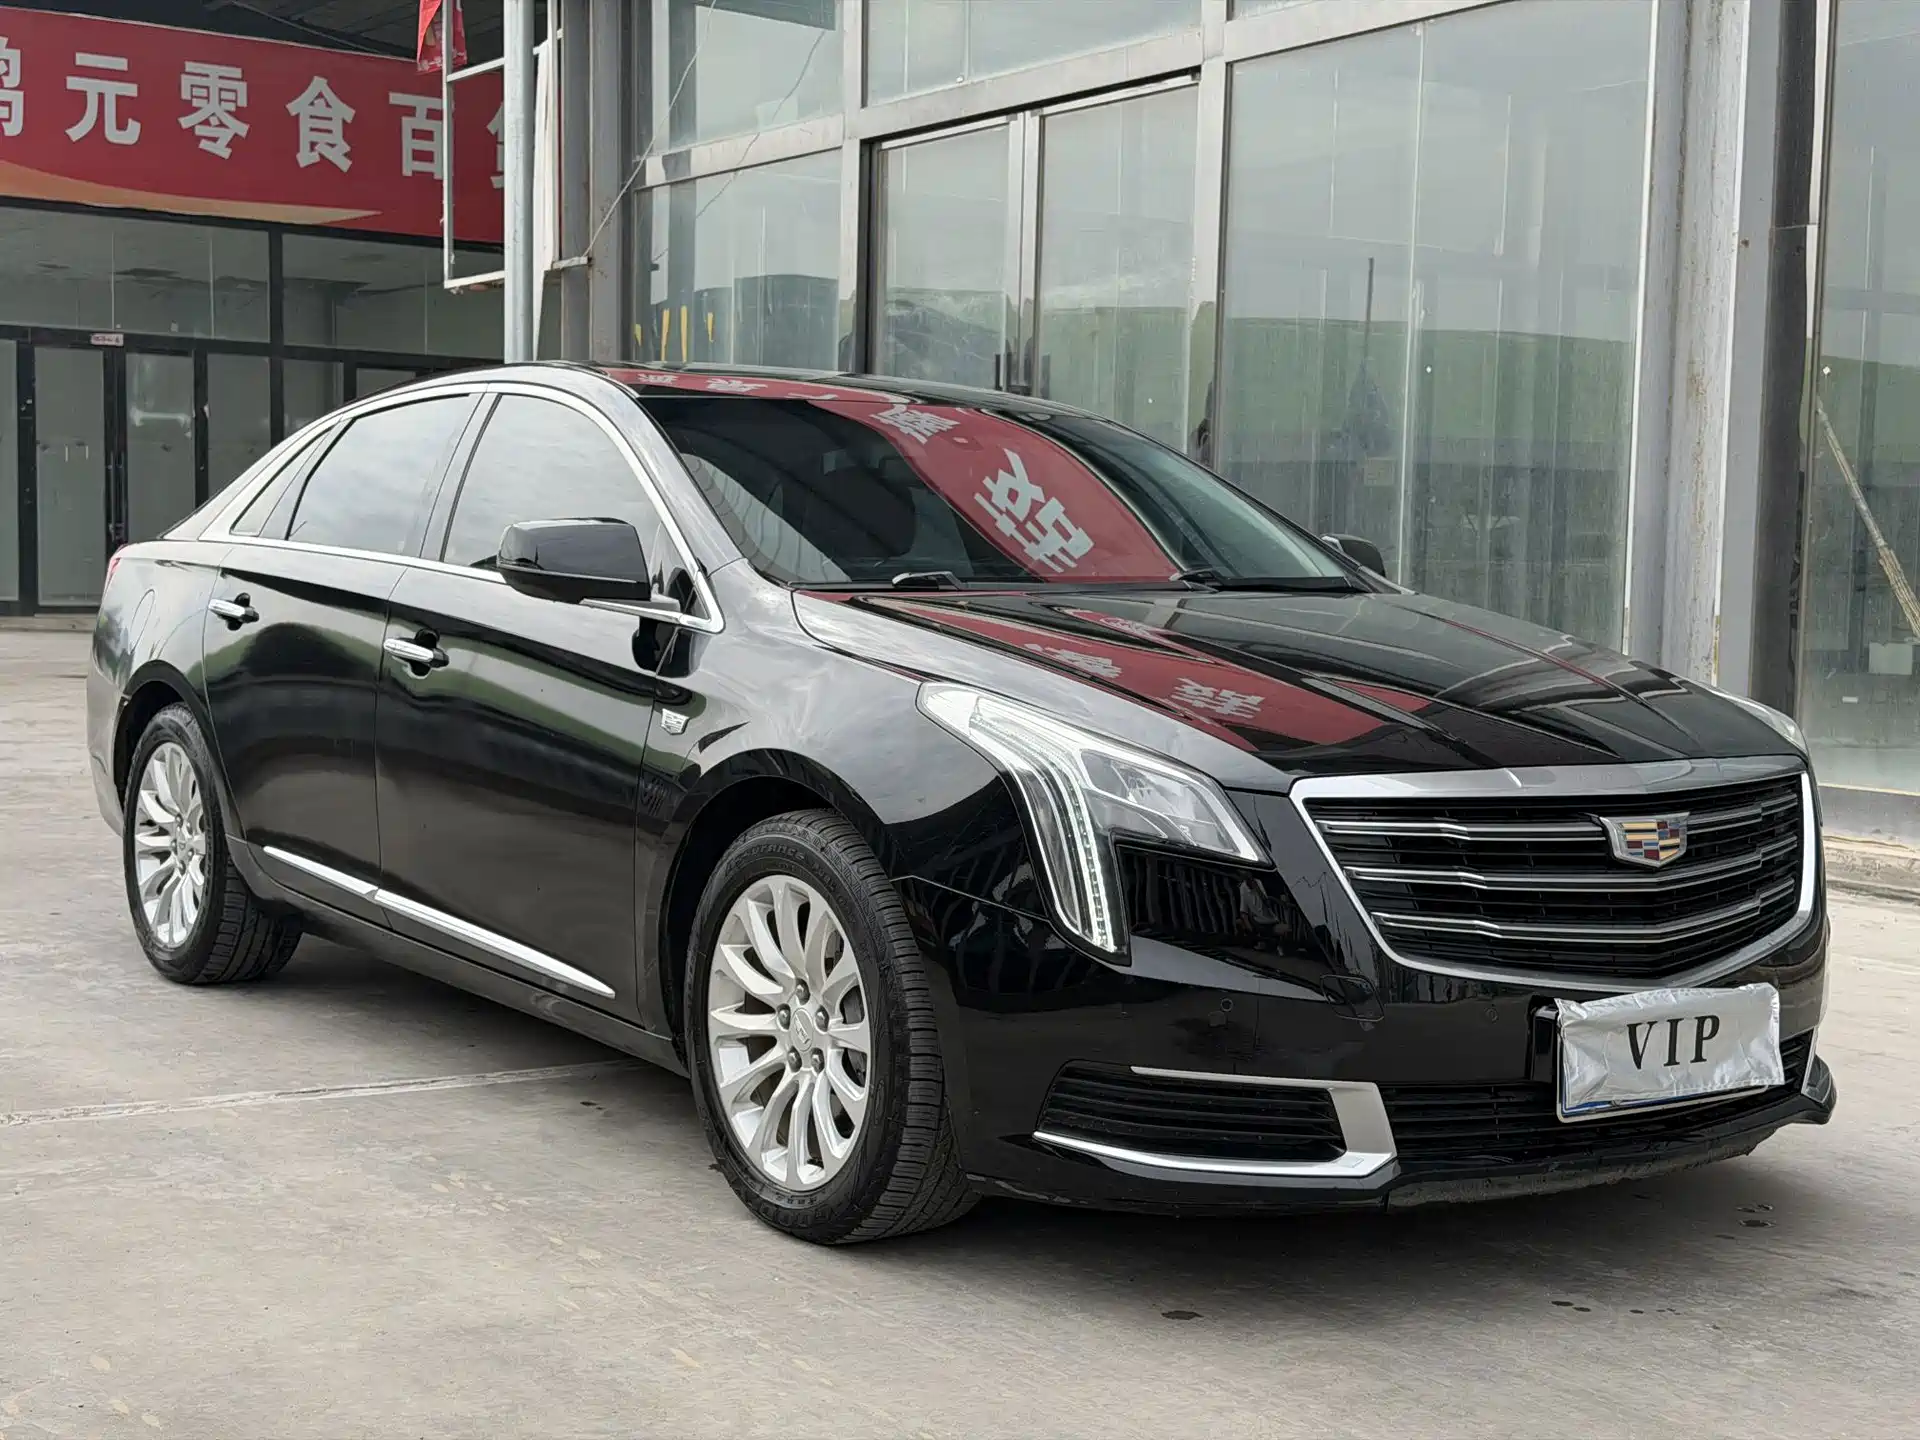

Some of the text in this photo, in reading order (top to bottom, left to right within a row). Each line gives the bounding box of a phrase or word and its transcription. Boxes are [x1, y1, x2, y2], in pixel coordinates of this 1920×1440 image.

[0, 36, 504, 189] 元零食百
[1627, 1014, 1719, 1070] VIP
